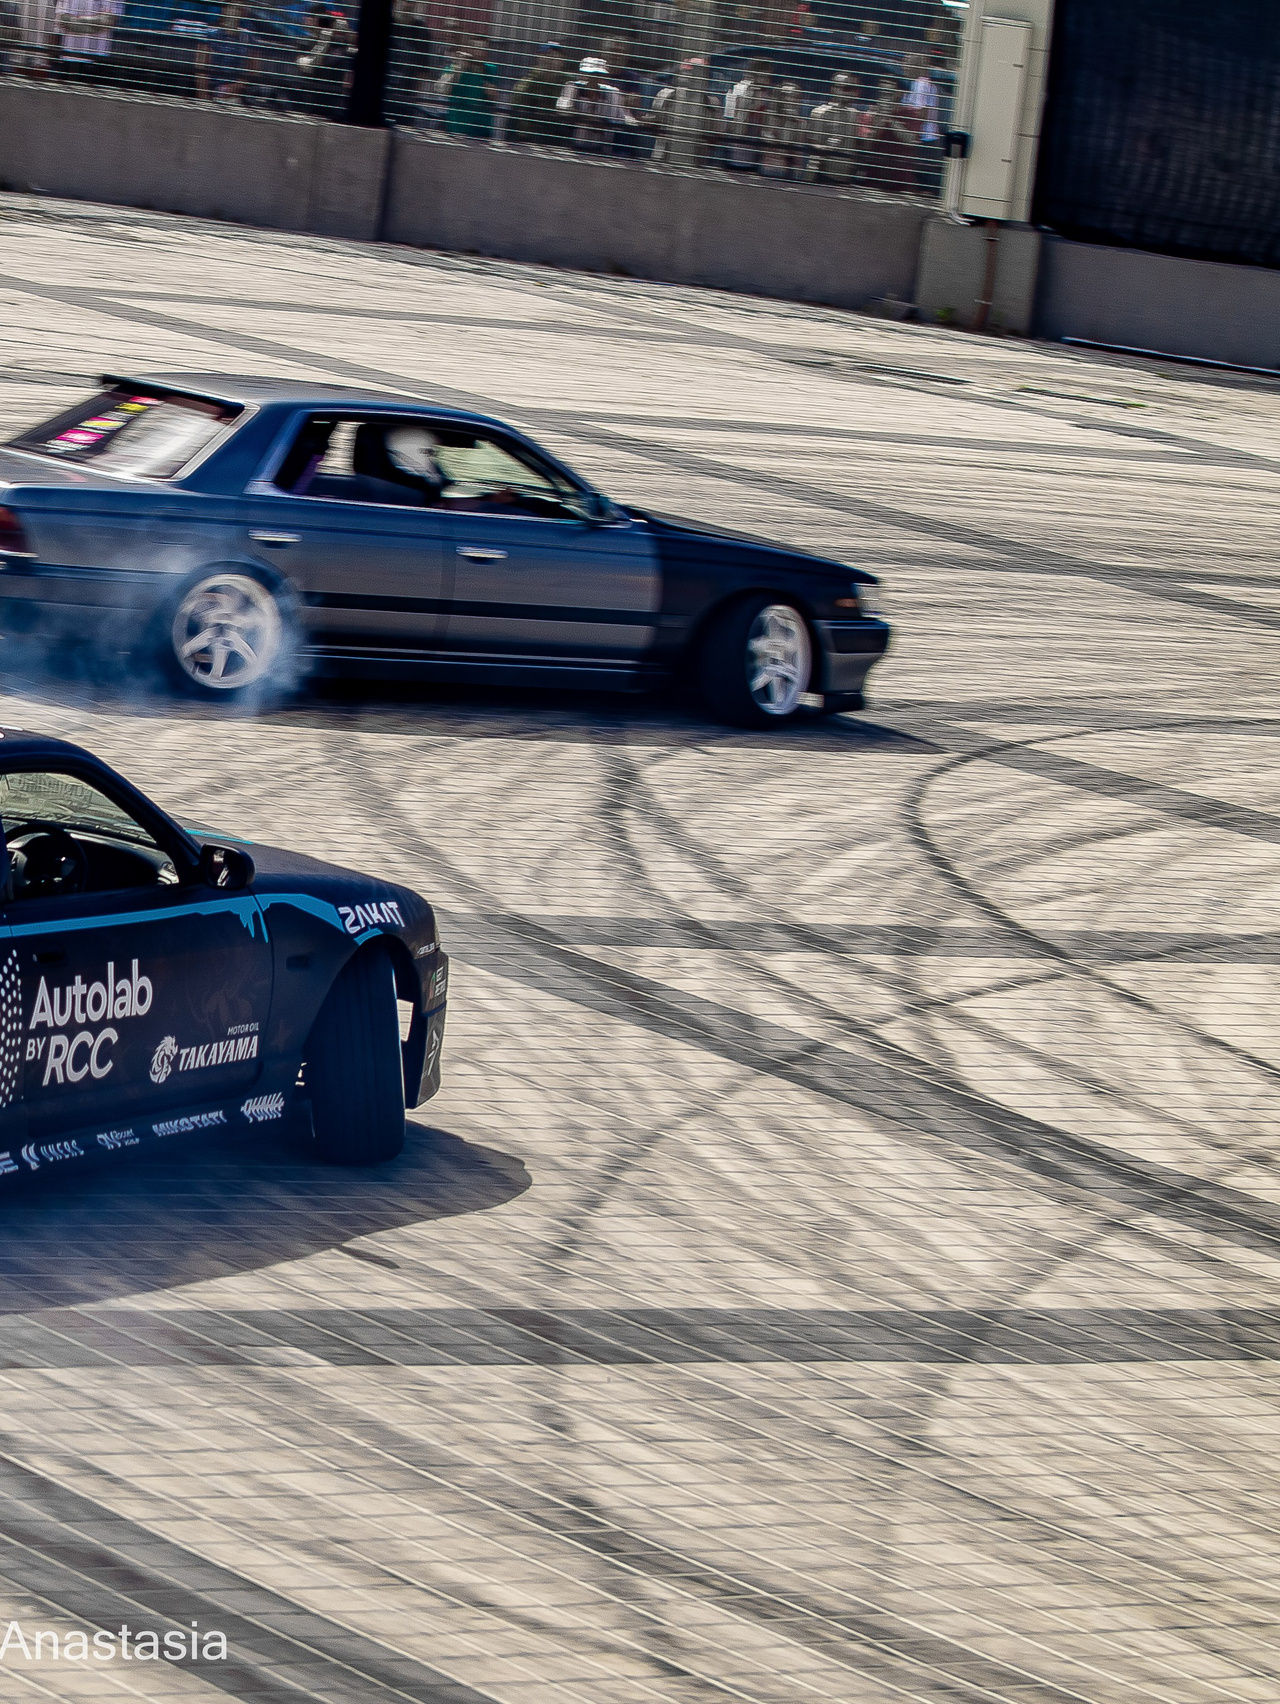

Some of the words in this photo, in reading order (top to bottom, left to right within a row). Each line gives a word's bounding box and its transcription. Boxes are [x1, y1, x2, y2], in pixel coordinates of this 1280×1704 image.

[29, 958, 153, 1030] Autolab
[227, 1024, 249, 1036] MOTOR
[249, 1022, 259, 1032] OIL
[26, 1037, 47, 1061] BY
[42, 1027, 119, 1086] RCC
[177, 1035, 259, 1071] TAKAYAMA
